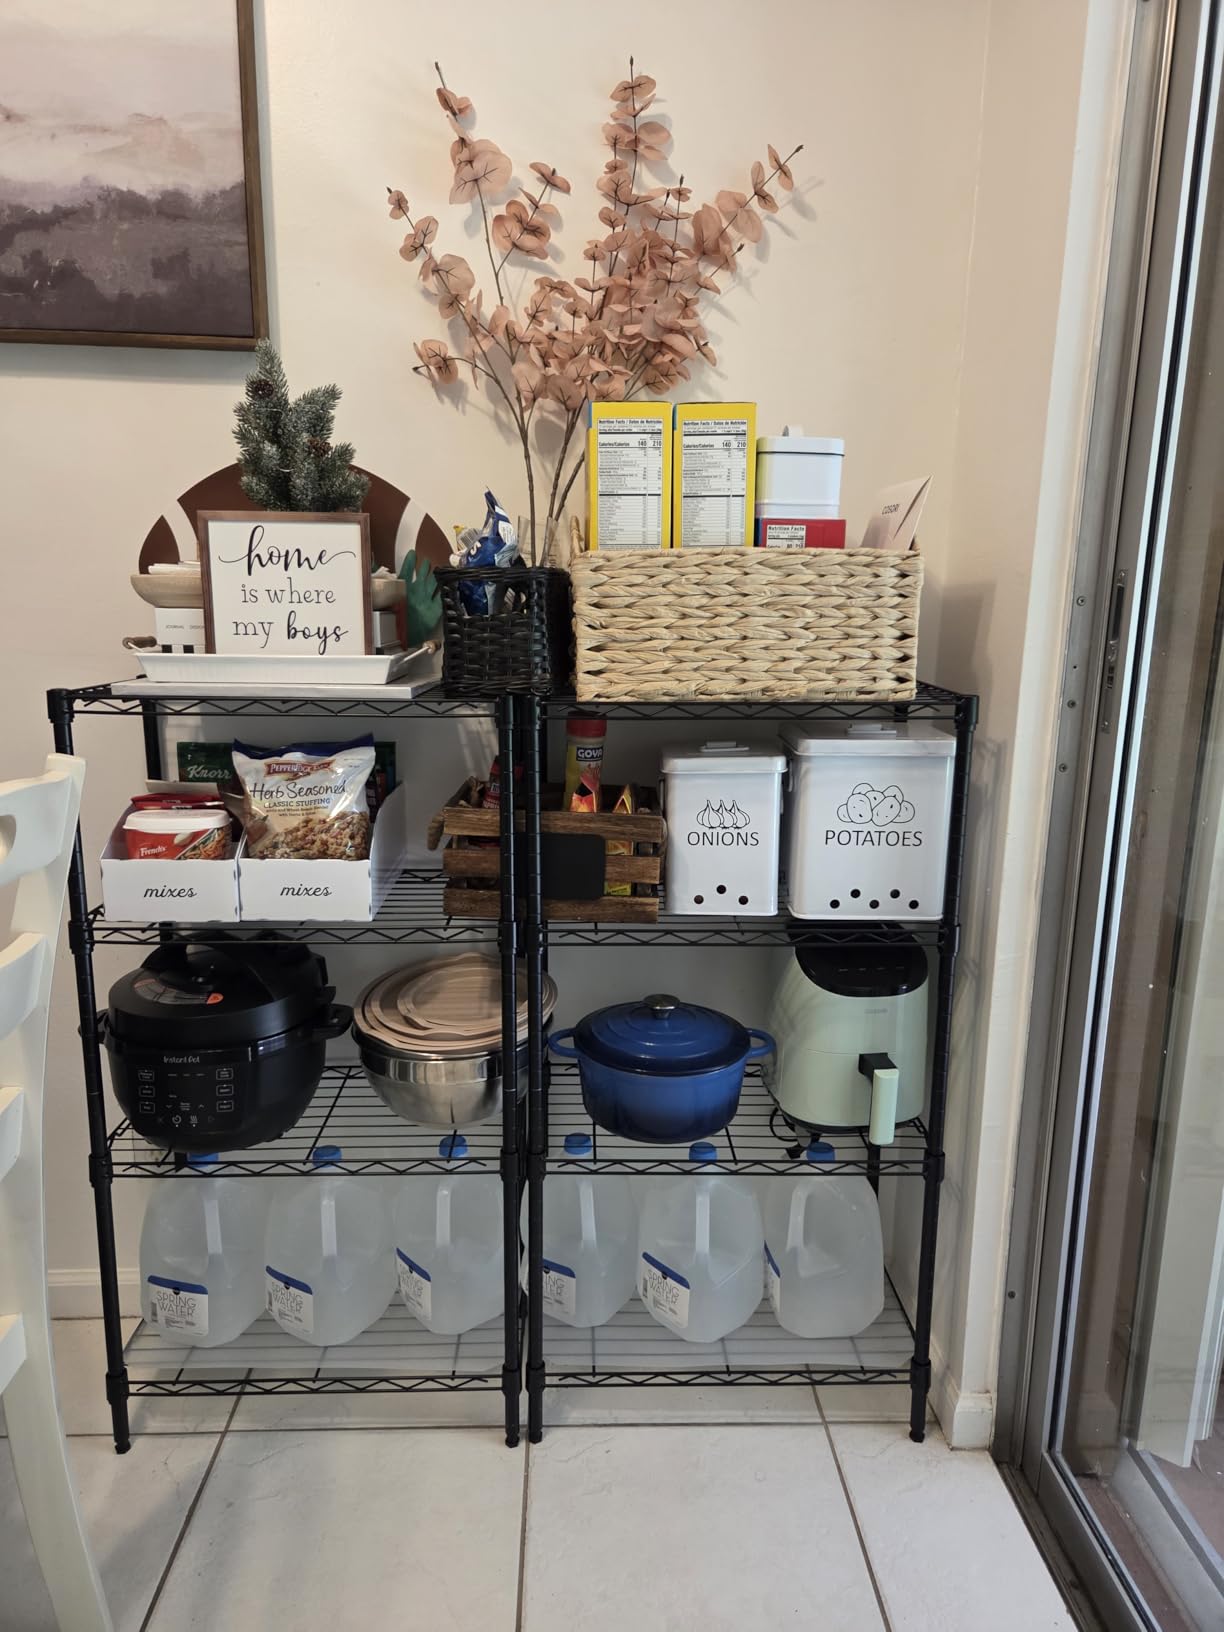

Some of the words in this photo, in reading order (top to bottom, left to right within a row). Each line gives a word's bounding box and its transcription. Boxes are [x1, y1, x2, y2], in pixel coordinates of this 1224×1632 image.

[218, 525, 356, 576] home
[241, 584, 258, 603] is
[265, 577, 336, 603] where
[232, 621, 274, 649] my
[287, 610, 349, 655] boys
[187, 765, 232, 779] Knorr
[250, 782, 285, 801] Herb
[286, 779, 346, 799] Seasoned
[263, 801, 294, 809] CLASSIC
[296, 798, 331, 807] STUFFING
[687, 831, 759, 847] ONIONS
[825, 830, 923, 847] POTATOES
[143, 885, 197, 898] mixes
[280, 883, 332, 897] mixes
[647, 1268, 680, 1298] SPRING
[157, 1291, 196, 1307] SPRING
[159, 1301, 196, 1318] WATER
